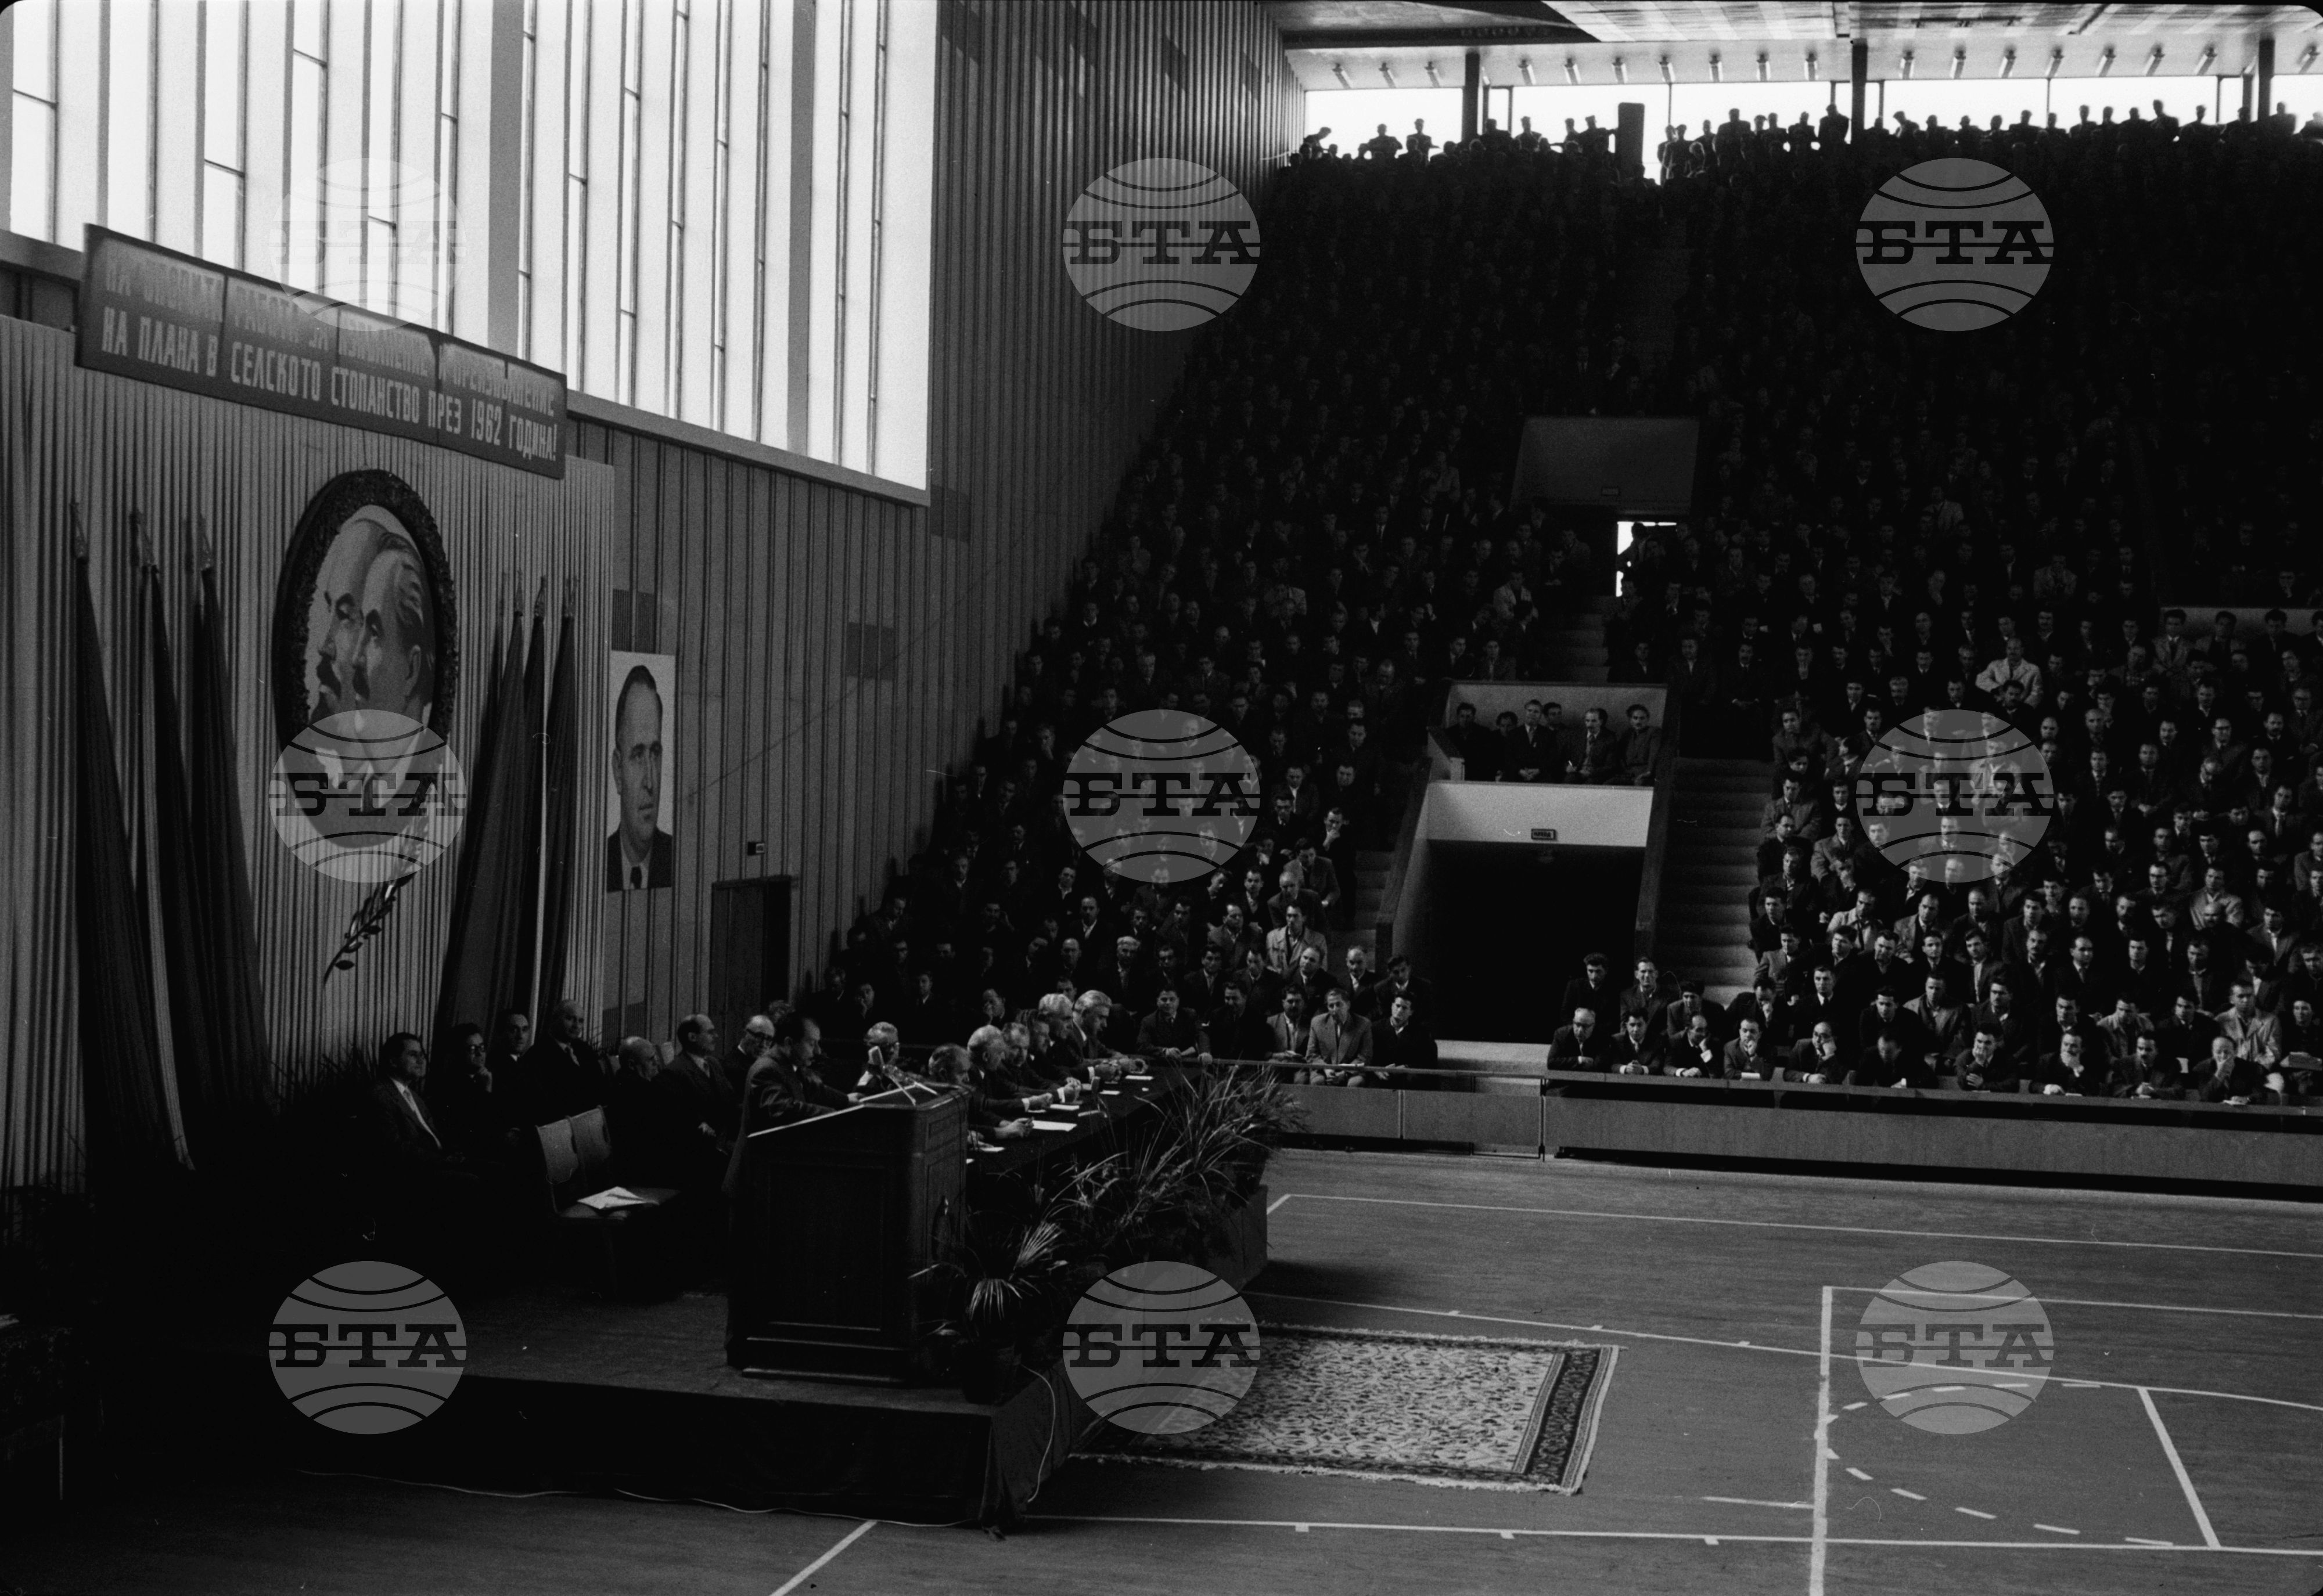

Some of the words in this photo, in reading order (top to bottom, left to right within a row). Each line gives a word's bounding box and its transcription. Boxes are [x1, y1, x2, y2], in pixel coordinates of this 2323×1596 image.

[102, 306, 128, 356] НА
[138, 316, 199, 374] ПЛАНА
[206, 334, 219, 377] В
[231, 341, 321, 402] СЕЛСКОТО
[330, 366, 420, 424] СТОПАНСТВО
[427, 388, 462, 435] ПРЕЗ
[470, 398, 502, 446] 1962
[509, 414, 558, 462] ГОДИНА!
